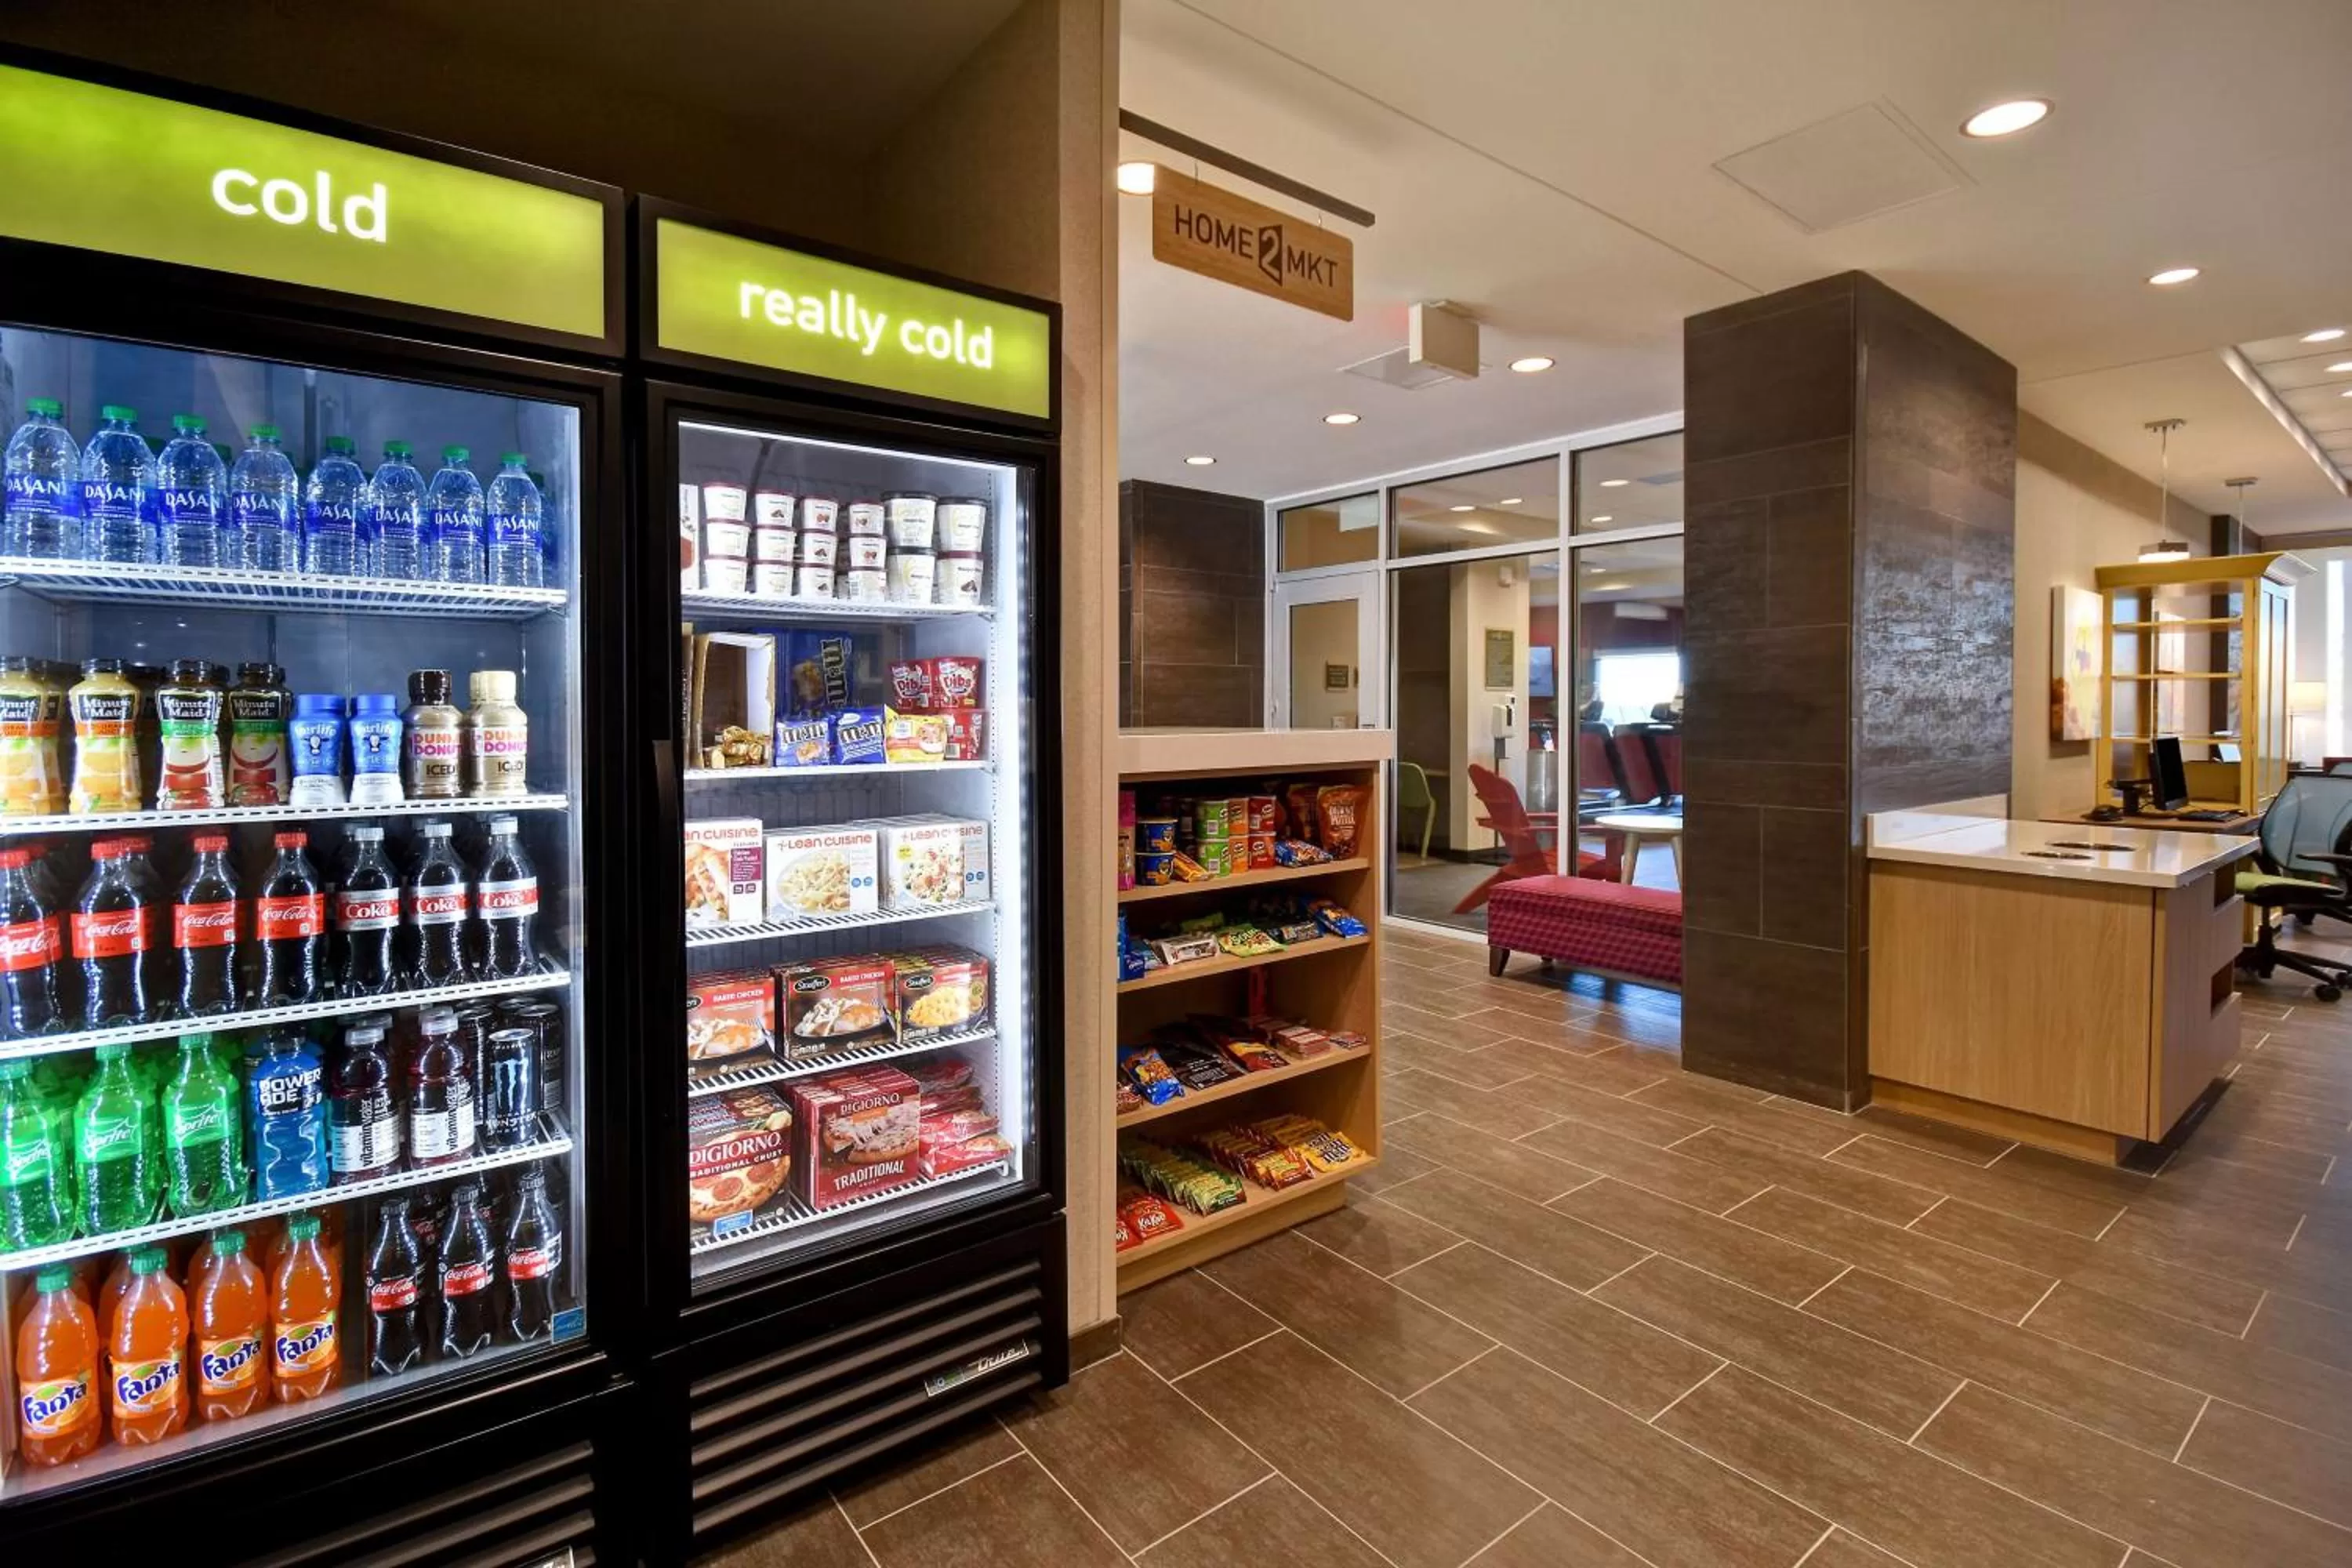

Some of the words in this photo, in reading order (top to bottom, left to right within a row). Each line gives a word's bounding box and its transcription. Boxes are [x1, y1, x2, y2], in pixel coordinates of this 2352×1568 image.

[212, 169, 387, 243] cold
[739, 279, 887, 357] really
[900, 315, 994, 369] cold
[6, 477, 67, 496] DASANI
[85, 484, 146, 503] DASANI
[314, 503, 355, 521] DASA
[435, 510, 483, 528] DASANI
[944, 673, 971, 688] Dibs
[83, 696, 132, 708] Minute
[163, 696, 211, 708] Minute
[234, 699, 275, 708] Minute
[169, 707, 205, 717] Maid
[239, 707, 270, 717] Maid
[787, 836, 822, 850] Lean
[825, 833, 873, 848] cuisine
[416, 898, 459, 914] Coke
[484, 892, 525, 909] Coke
[346, 902, 391, 919] Coke
[260, 1067, 321, 1094] POWER
[175, 1112, 221, 1136] Sprite
[359, 1097, 373, 1167] vitaminwater
[690, 1158, 750, 1178] RADITIONAL
[753, 1149, 783, 1163] CRUST
[833, 1160, 905, 1192] TRADITIONAL
[277, 1322, 335, 1363] Fanta
[201, 1338, 263, 1381] Fanta
[117, 1360, 180, 1403] Fanta
[22, 1379, 88, 1425] Fanta
